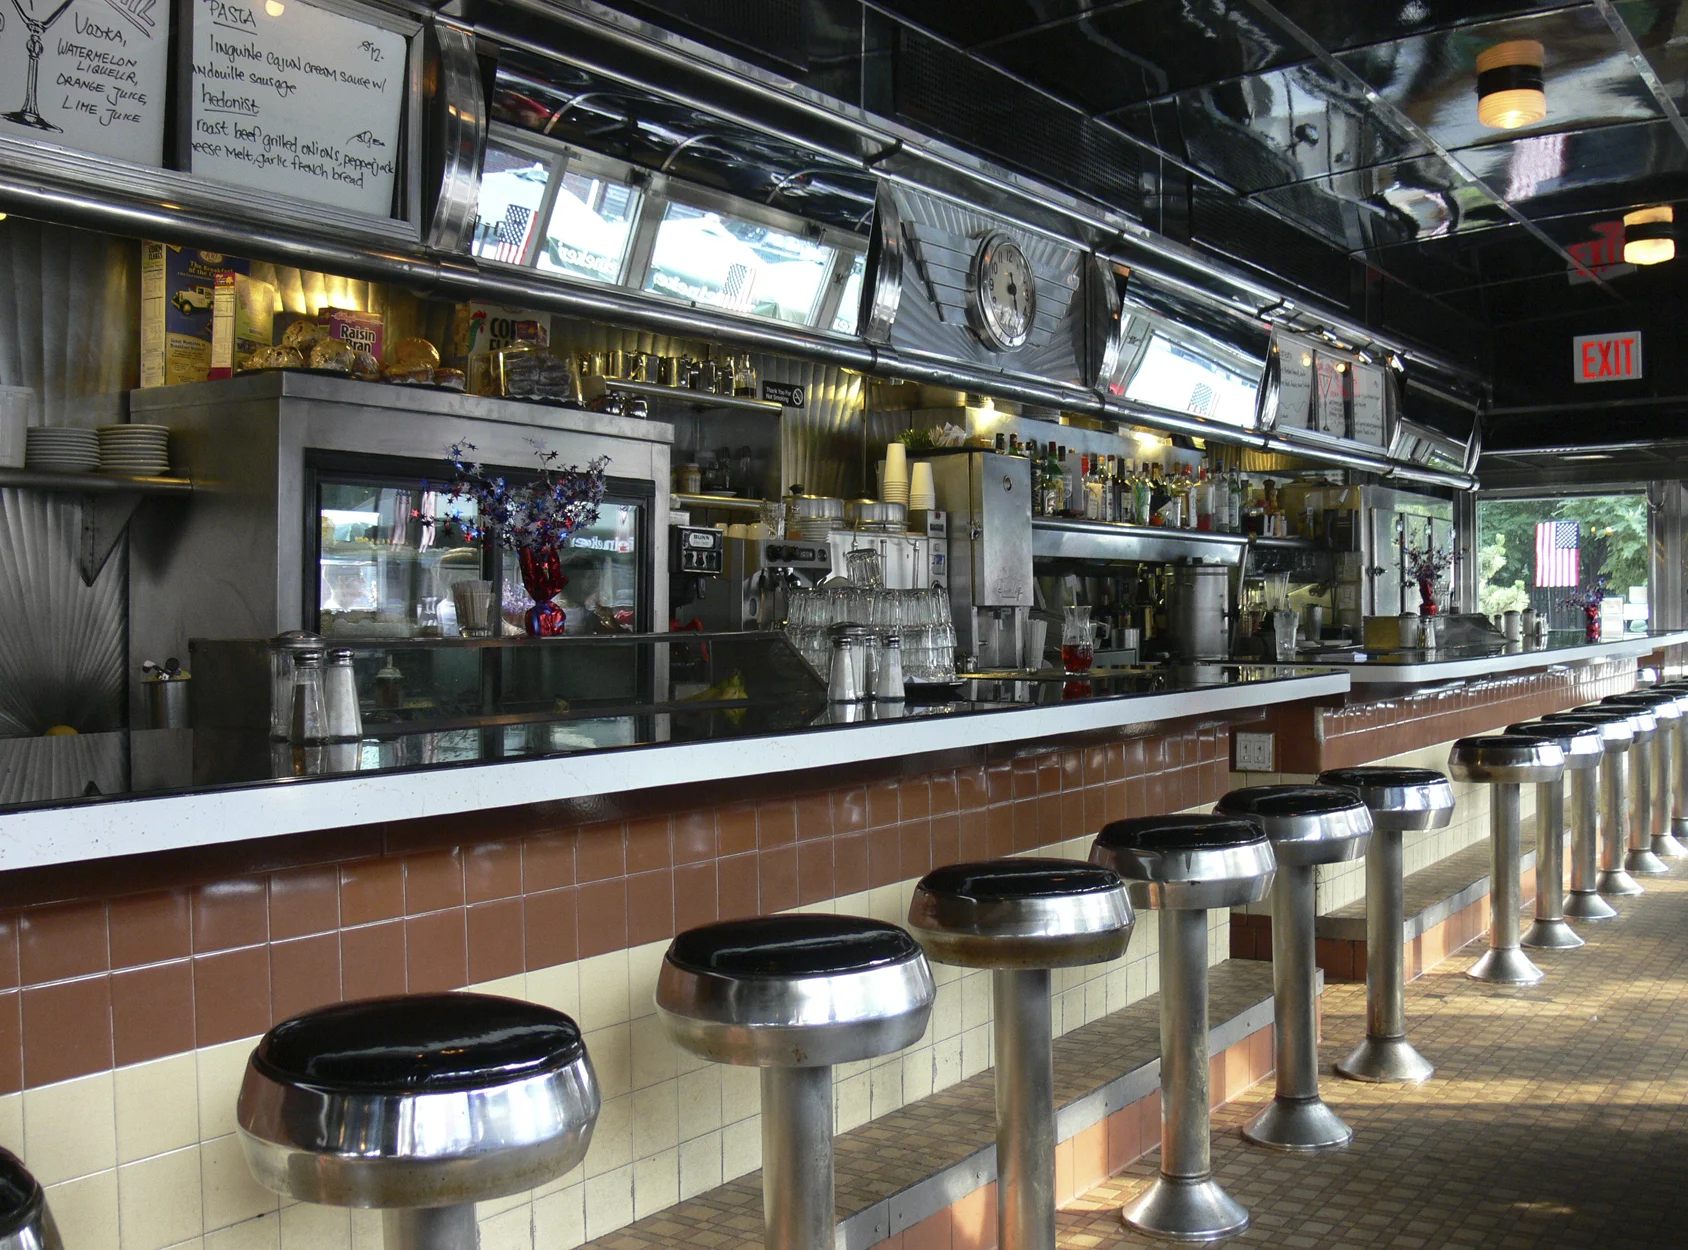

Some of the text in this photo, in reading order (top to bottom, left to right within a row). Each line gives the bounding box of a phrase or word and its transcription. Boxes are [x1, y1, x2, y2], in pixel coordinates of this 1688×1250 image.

[208, 0, 257, 28] PASTA
[57, 38, 138, 67] WATERMELON
[56, 73, 106, 93] ORANGE
[62, 95, 142, 127] LIME JUICE
[196, 118, 230, 137] roast
[331, 167, 365, 190] bread
[340, 324, 376, 343] Raisin
[345, 339, 372, 354] Bran
[1582, 338, 1635, 380] EXIT
[773, 395, 789, 403] Smoking
